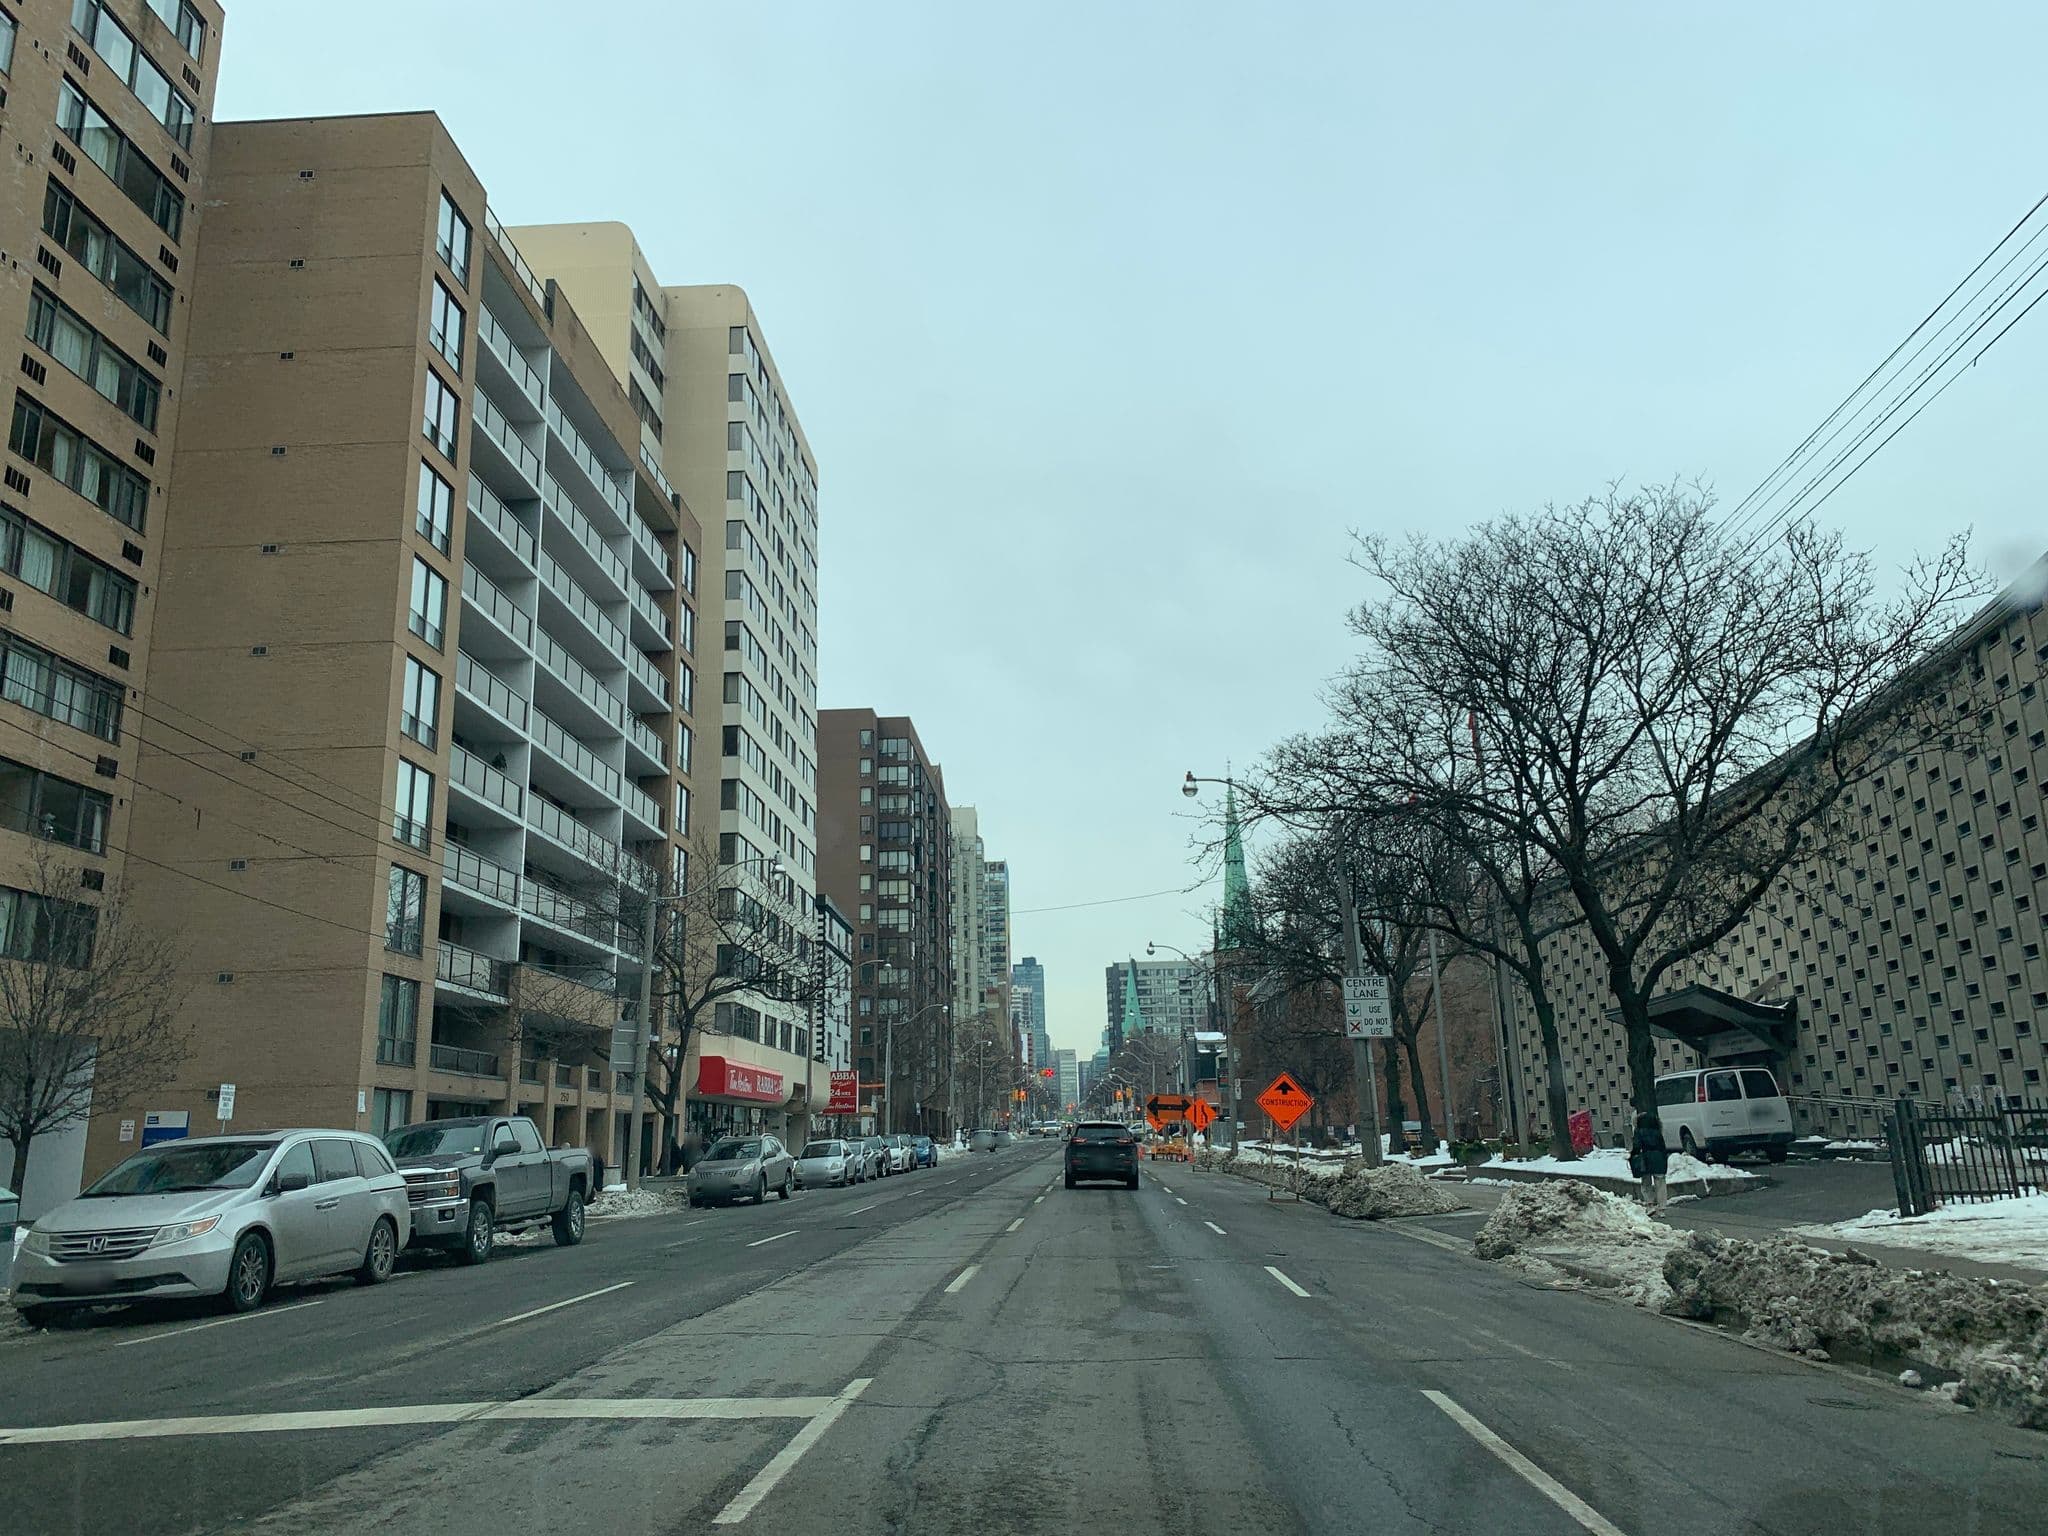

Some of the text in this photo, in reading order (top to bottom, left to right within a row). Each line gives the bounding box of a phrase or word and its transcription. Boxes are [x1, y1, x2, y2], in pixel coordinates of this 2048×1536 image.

[1345, 978, 1385, 988] CENTRE
[1353, 989, 1379, 998] LANE
[1368, 1005, 1382, 1013] USE
[1364, 1017, 1388, 1026] DO NOT
[1370, 1027, 1384, 1035] USE
[831, 1072, 856, 1081] ABBA
[1261, 1098, 1308, 1107] CONSTRUCTION
